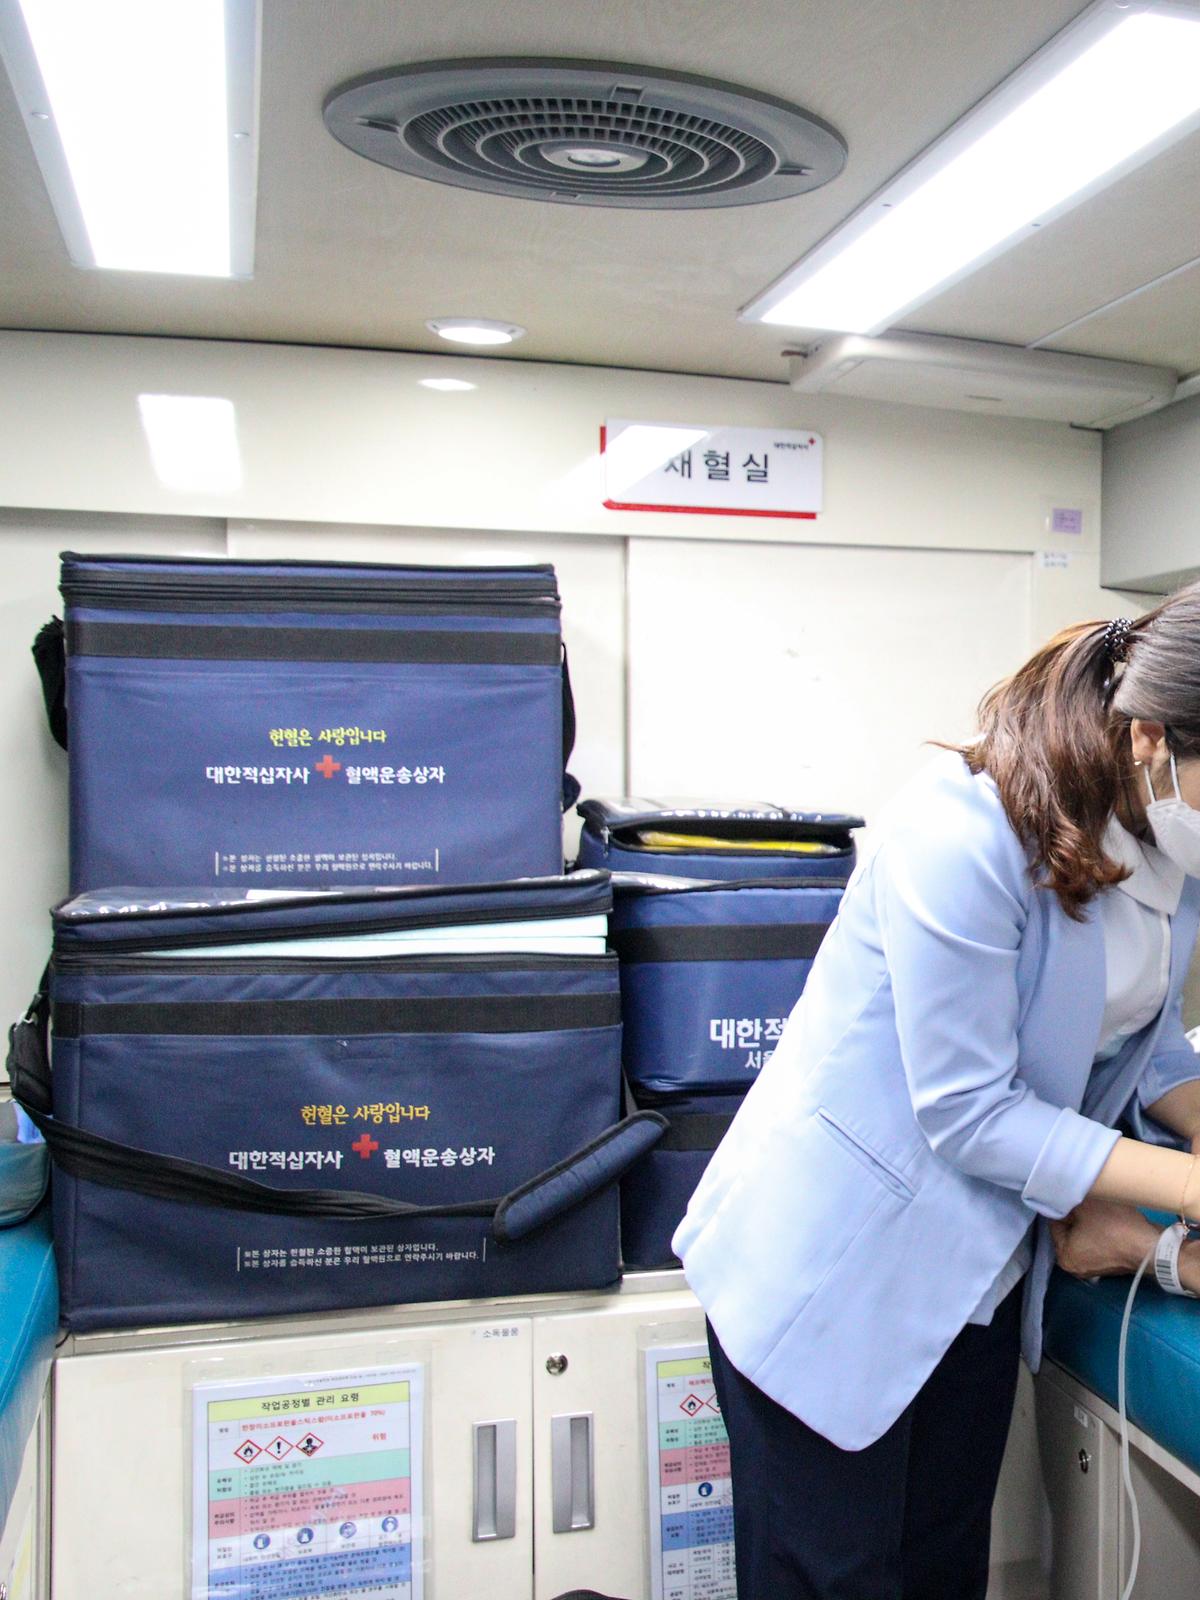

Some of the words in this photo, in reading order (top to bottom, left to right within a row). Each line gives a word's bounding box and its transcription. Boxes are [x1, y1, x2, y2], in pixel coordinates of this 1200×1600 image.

[269, 728, 313, 747] 헌혈은
[318, 726, 388, 746] 사랑입니다
[206, 765, 310, 785] 대한적십자사
[345, 765, 446, 785] 혈액운송상자
[301, 1104, 349, 1125] 헌혈은
[353, 1102, 431, 1124] 사랑입니다
[229, 1149, 344, 1170] 대한적십자사
[383, 1146, 496, 1169] 혈액운송상자
[261, 1395, 311, 1412] 작업공정별
[316, 1395, 335, 1407] 관리
[341, 1392, 360, 1403] 요령
